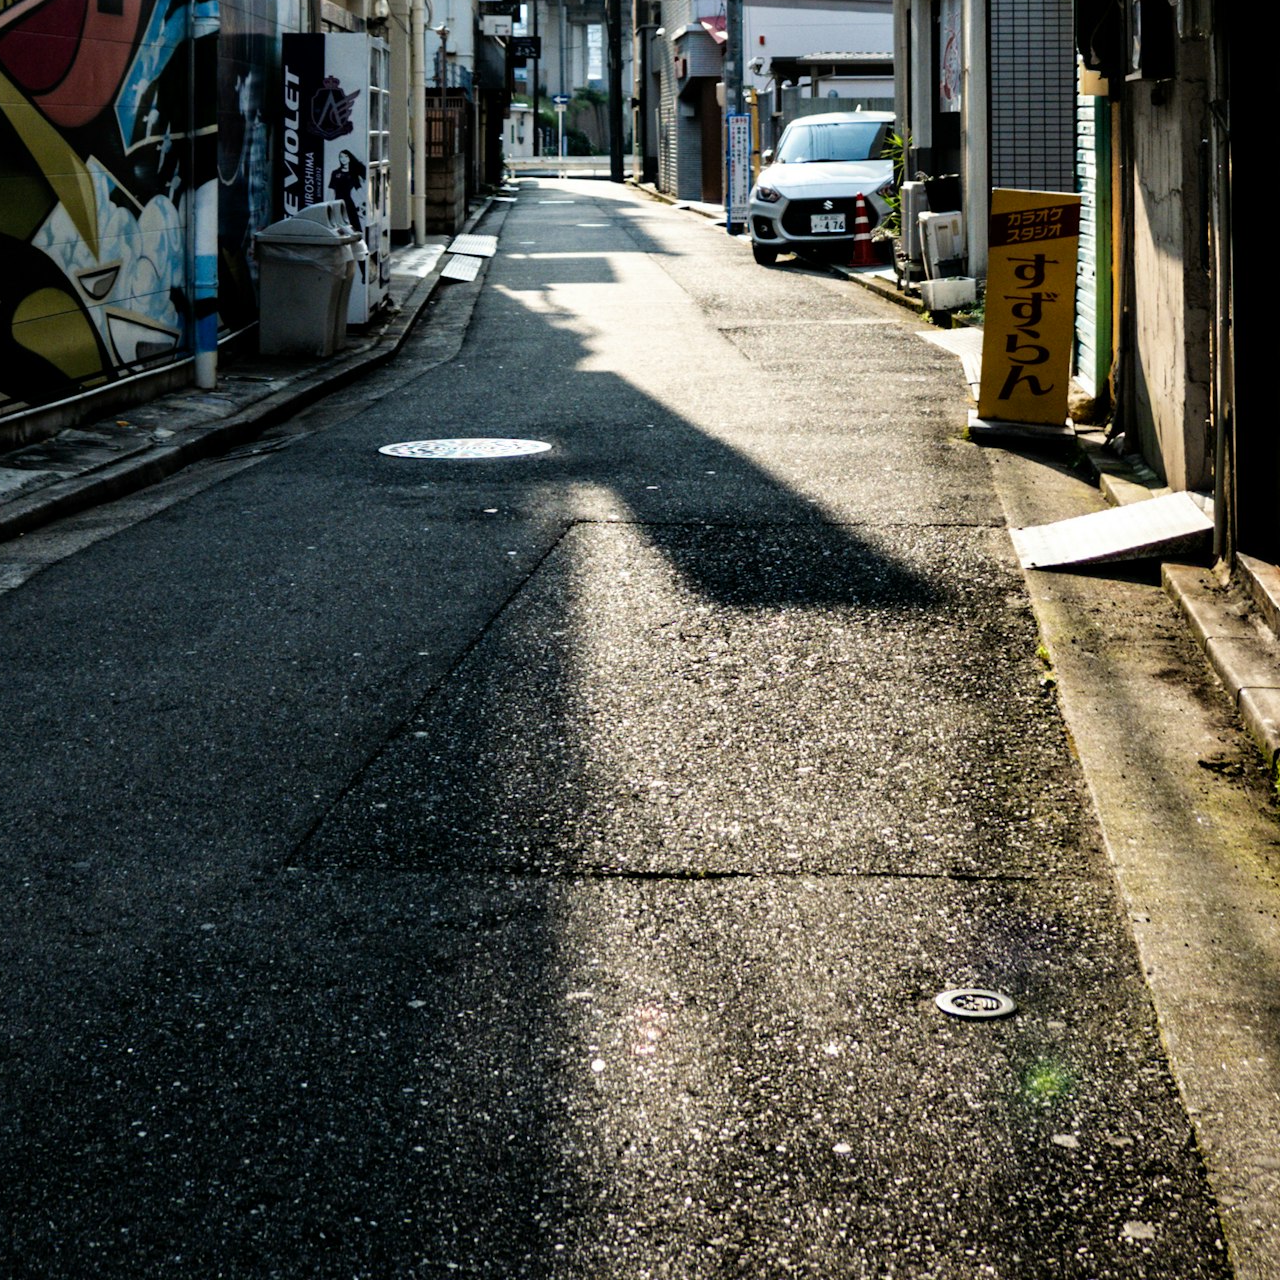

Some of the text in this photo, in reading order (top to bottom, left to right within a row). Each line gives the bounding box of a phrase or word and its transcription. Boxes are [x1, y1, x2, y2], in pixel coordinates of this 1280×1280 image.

[283, 64, 300, 188] VIOLET
[1006, 223, 1062, 243] スタジオ
[1007, 207, 1063, 226] カラオケ
[998, 253, 1060, 400] すずらん
